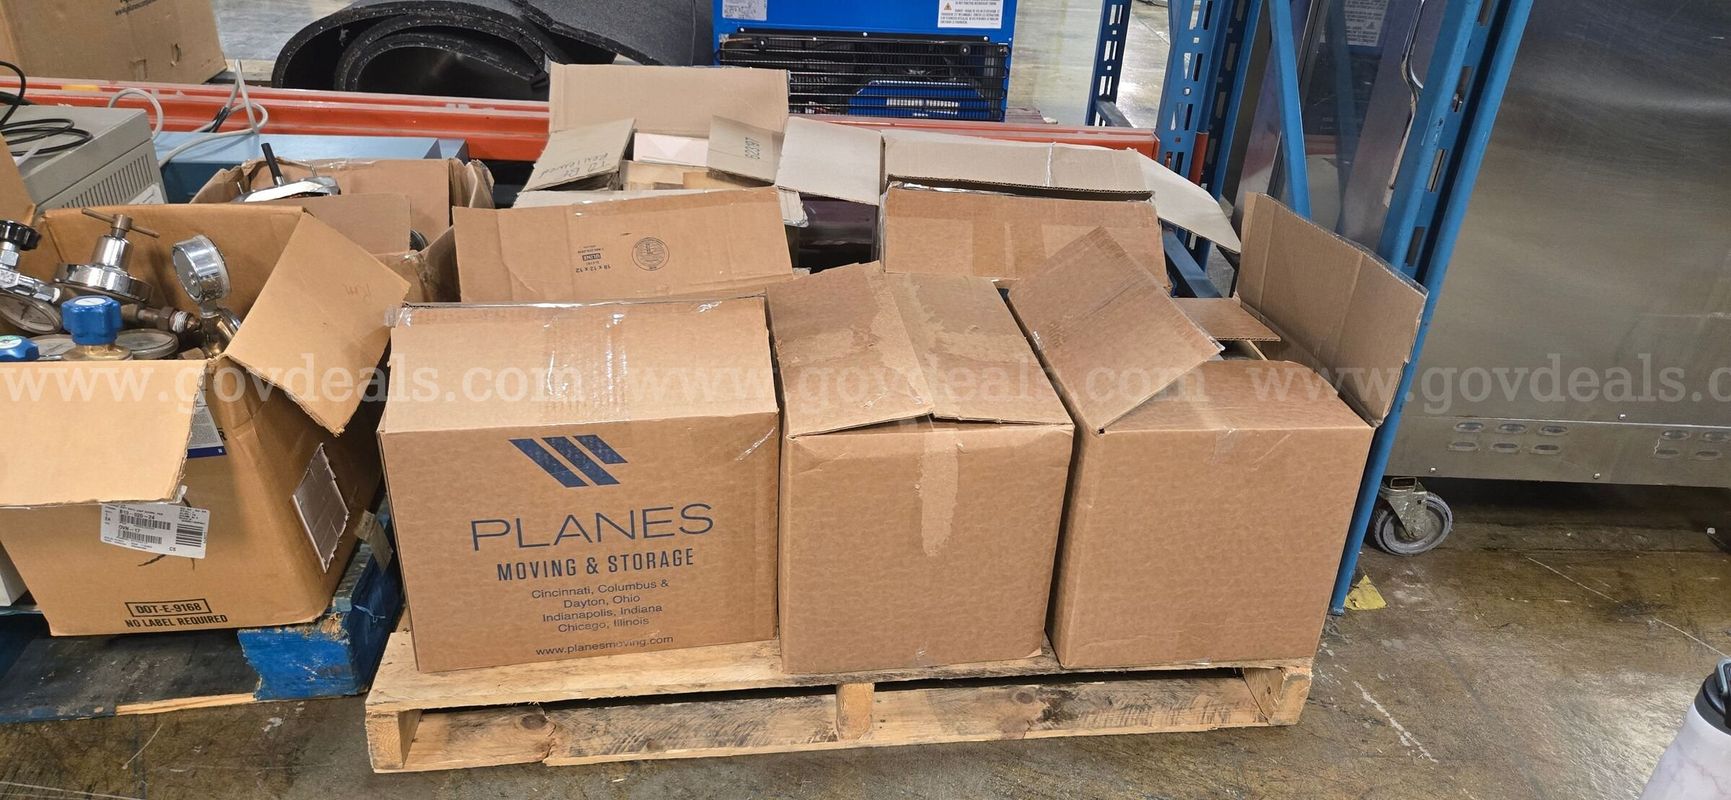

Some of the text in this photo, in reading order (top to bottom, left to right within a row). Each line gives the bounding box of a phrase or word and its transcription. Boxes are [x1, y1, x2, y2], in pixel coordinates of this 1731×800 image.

[471, 503, 714, 552] PLANES
[497, 548, 695, 582] MOVING & STORAGE
[532, 579, 669, 599] Cincinnati, Columbus &
[134, 602, 202, 614] DOT-E-9168
[564, 594, 641, 609] Dayton, Ohio
[125, 615, 228, 628] NO LABEL REQUIRED
[543, 604, 663, 623] Indianapolis, Indiana
[558, 617, 650, 634] Chicago, Illinois
[535, 634, 674, 656] www.planesmoving.com
